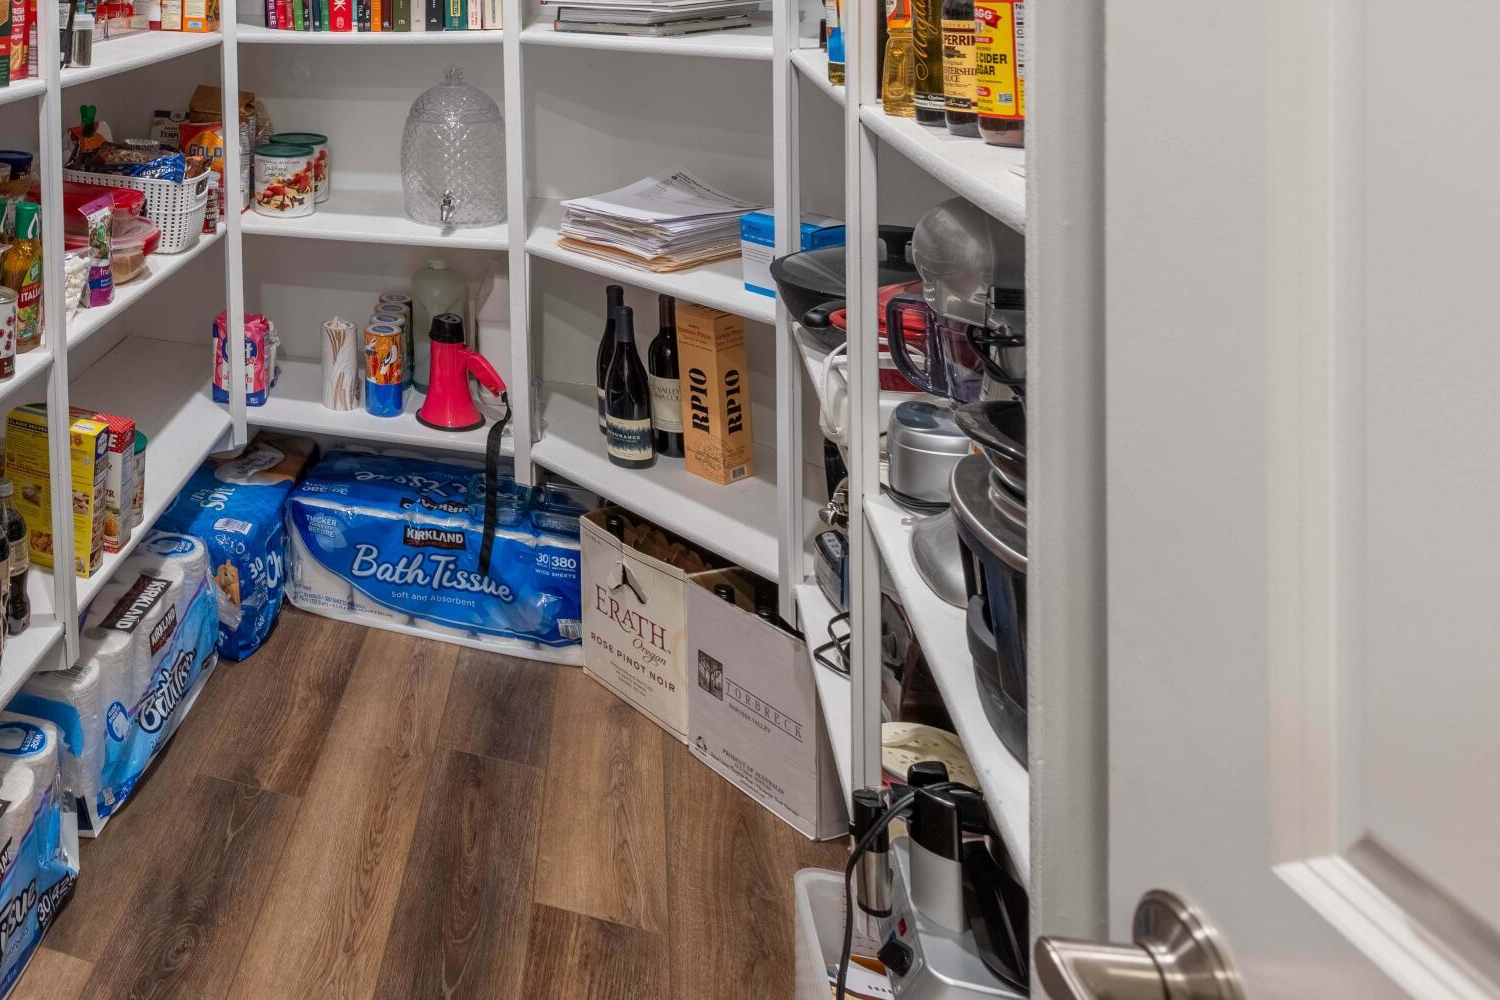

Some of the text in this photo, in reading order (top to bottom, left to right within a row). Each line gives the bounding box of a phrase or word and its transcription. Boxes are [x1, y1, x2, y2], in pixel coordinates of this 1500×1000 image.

[980, 53, 1008, 64] CIDER
[189, 144, 223, 157] GOLD
[657, 387, 680, 395] VALLEY
[306, 515, 337, 526] THICKER
[406, 528, 464, 544] KIRKLAND
[536, 553, 577, 569] 30 380
[352, 544, 513, 602] Bath Tissue
[116, 580, 166, 629] KIRKLAND
[391, 591, 476, 608] Soft and Absorbent
[594, 583, 668, 652] ERATH
[151, 611, 175, 645] KIRKLAND
[590, 632, 614, 654] ROSE
[617, 649, 646, 674] PINOT
[649, 671, 676, 693] NOIR
[632, 638, 668, 667] Oregon
[725, 682, 803, 738] TORBRECK
[752, 718, 771, 734] VALLEY
[32, 731, 46, 751] WIDE
[722, 749, 785, 795] PRODUCT AUSTRALIA
